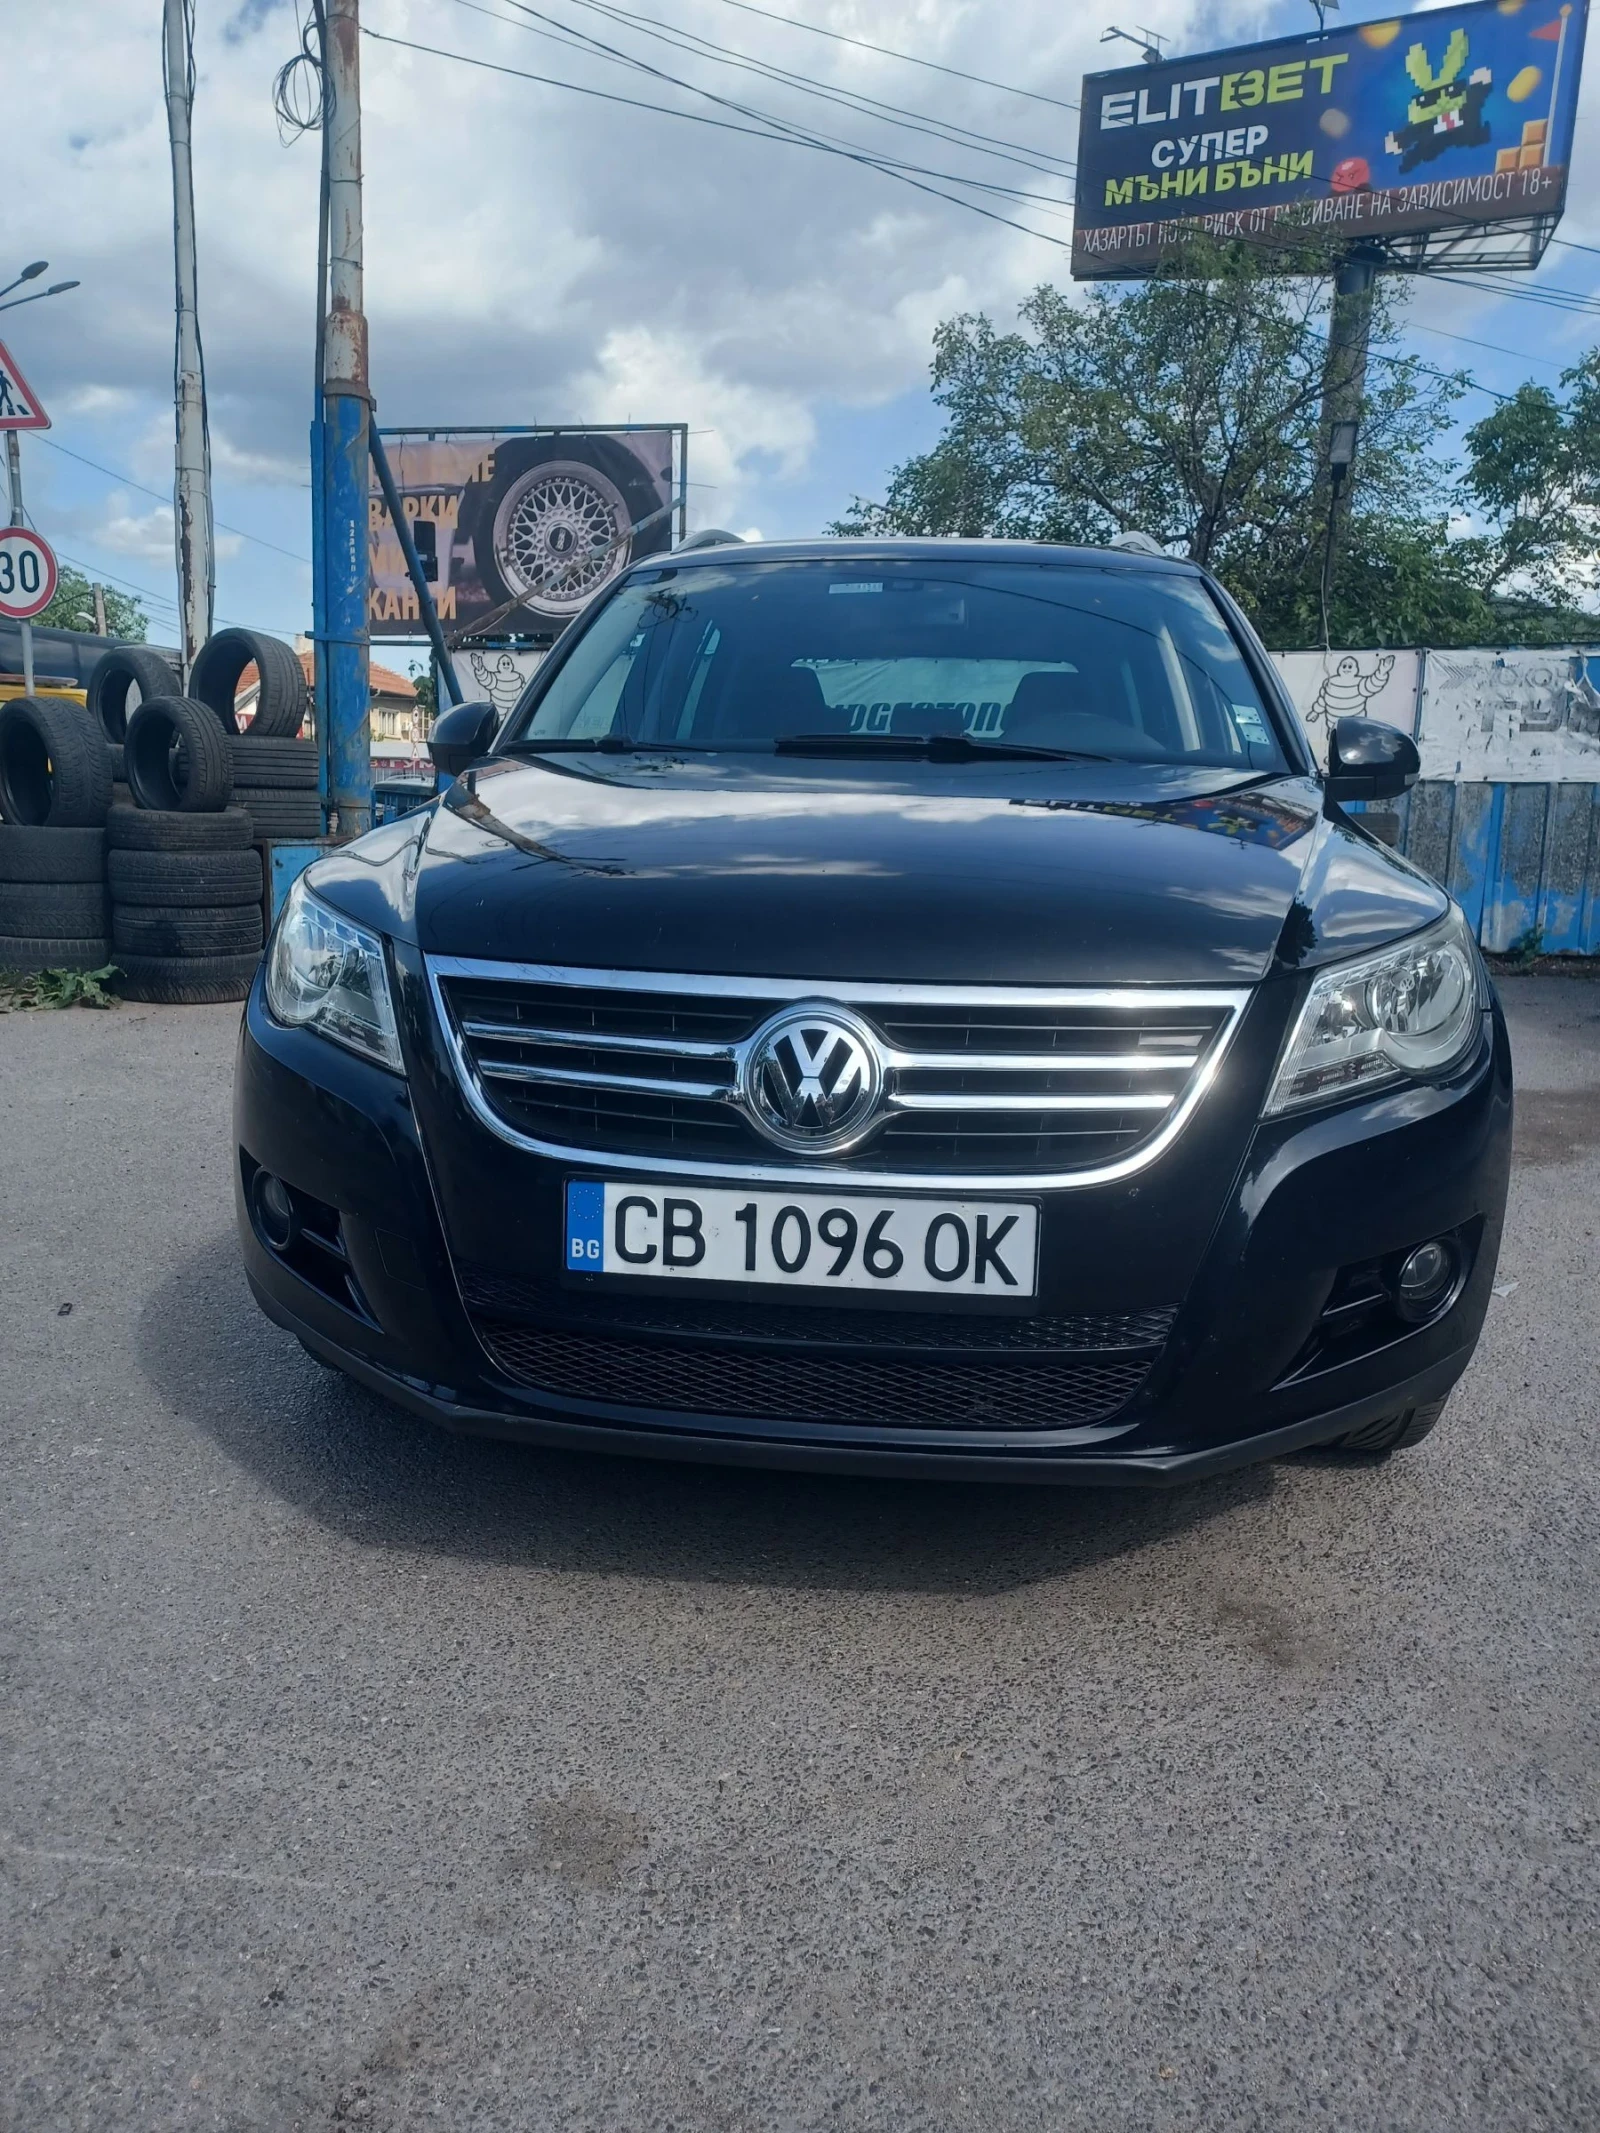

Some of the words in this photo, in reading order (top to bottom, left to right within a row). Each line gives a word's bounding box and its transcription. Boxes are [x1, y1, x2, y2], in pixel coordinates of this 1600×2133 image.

[1151, 124, 1269, 169] СУПЕР
[1104, 166, 1208, 206] МЪНИ
[1214, 150, 1315, 192] БЪНИ
[1083, 222, 1154, 252] ХАЗАРТЪТ
[1204, 208, 1244, 238] РИСК
[1249, 206, 1269, 233] ОТ
[1273, 193, 1366, 228] РВИВАНЕ
[1371, 190, 1392, 217] НА
[1397, 172, 1513, 213] ЗАВИСИМОСТ
[1521, 168, 1553, 197] 18+
[0, 550, 40, 594] 30
[754, 1017, 872, 1138] VW
[571, 1238, 600, 1260] BG
[614, 1195, 706, 1267] CB
[735, 1202, 904, 1279] 1096
[925, 1211, 1020, 1287] OK
